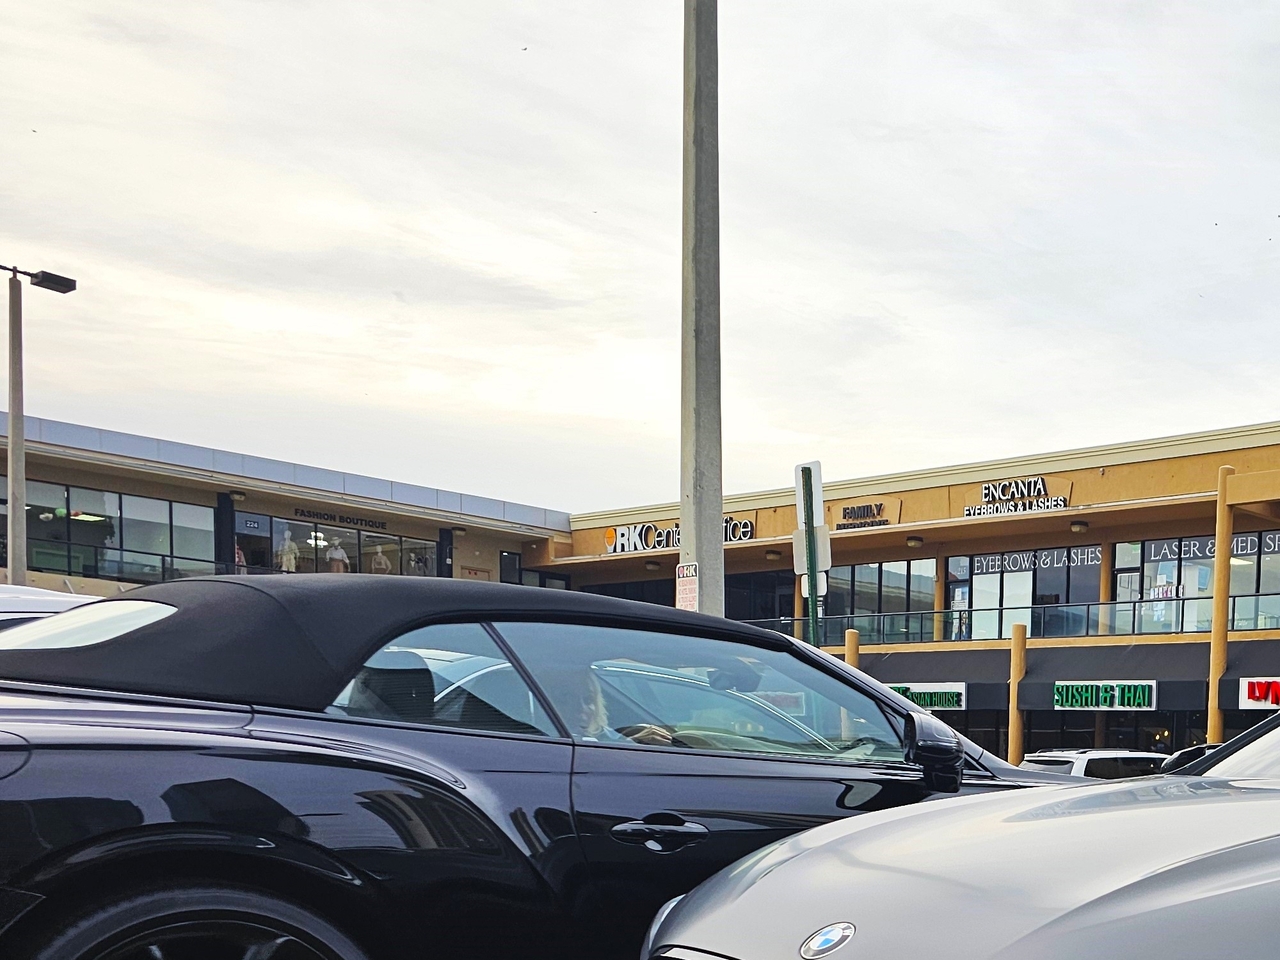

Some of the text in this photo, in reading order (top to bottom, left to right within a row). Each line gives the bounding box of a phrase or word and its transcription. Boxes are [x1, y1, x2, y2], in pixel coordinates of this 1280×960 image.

[981, 477, 1045, 501] ENCANTA
[842, 503, 883, 519] FAMILY
[964, 496, 1065, 517] EYEBROWS & LASHES
[246, 520, 258, 528] 224
[294, 508, 387, 530] FASHION BOUTIQUE
[974, 548, 1102, 573] EYEBROWS & LASHES
[1151, 541, 1202, 560] LASER
[1206, 540, 1216, 556] &
[932, 692, 960, 707] HOUSE
[1054, 684, 1151, 707] SUSHI & THAI
